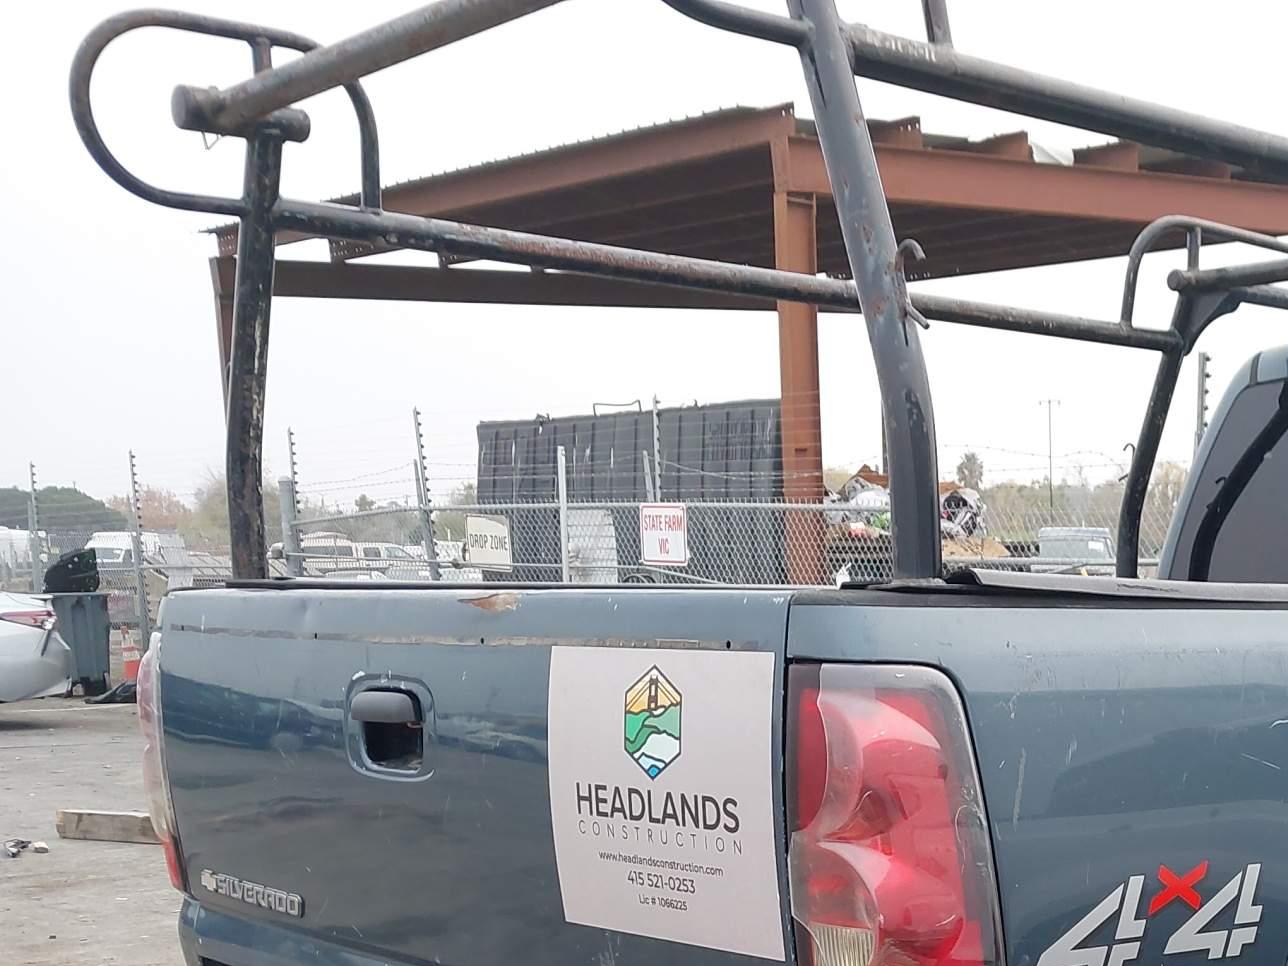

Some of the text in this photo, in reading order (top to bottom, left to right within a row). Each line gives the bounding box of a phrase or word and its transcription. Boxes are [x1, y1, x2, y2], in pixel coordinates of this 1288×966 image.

[644, 514, 683, 532] STATE FARM
[469, 533, 508, 551] DROP ZONE
[575, 782, 741, 834] HEADLANDS
[577, 819, 743, 856] CONSTRUCTION
[598, 850, 724, 877] www.headlandsconstruction.com
[216, 872, 303, 917] SILVERADO
[627, 870, 696, 895] 415 521-0253
[638, 894, 650, 906] Lic
